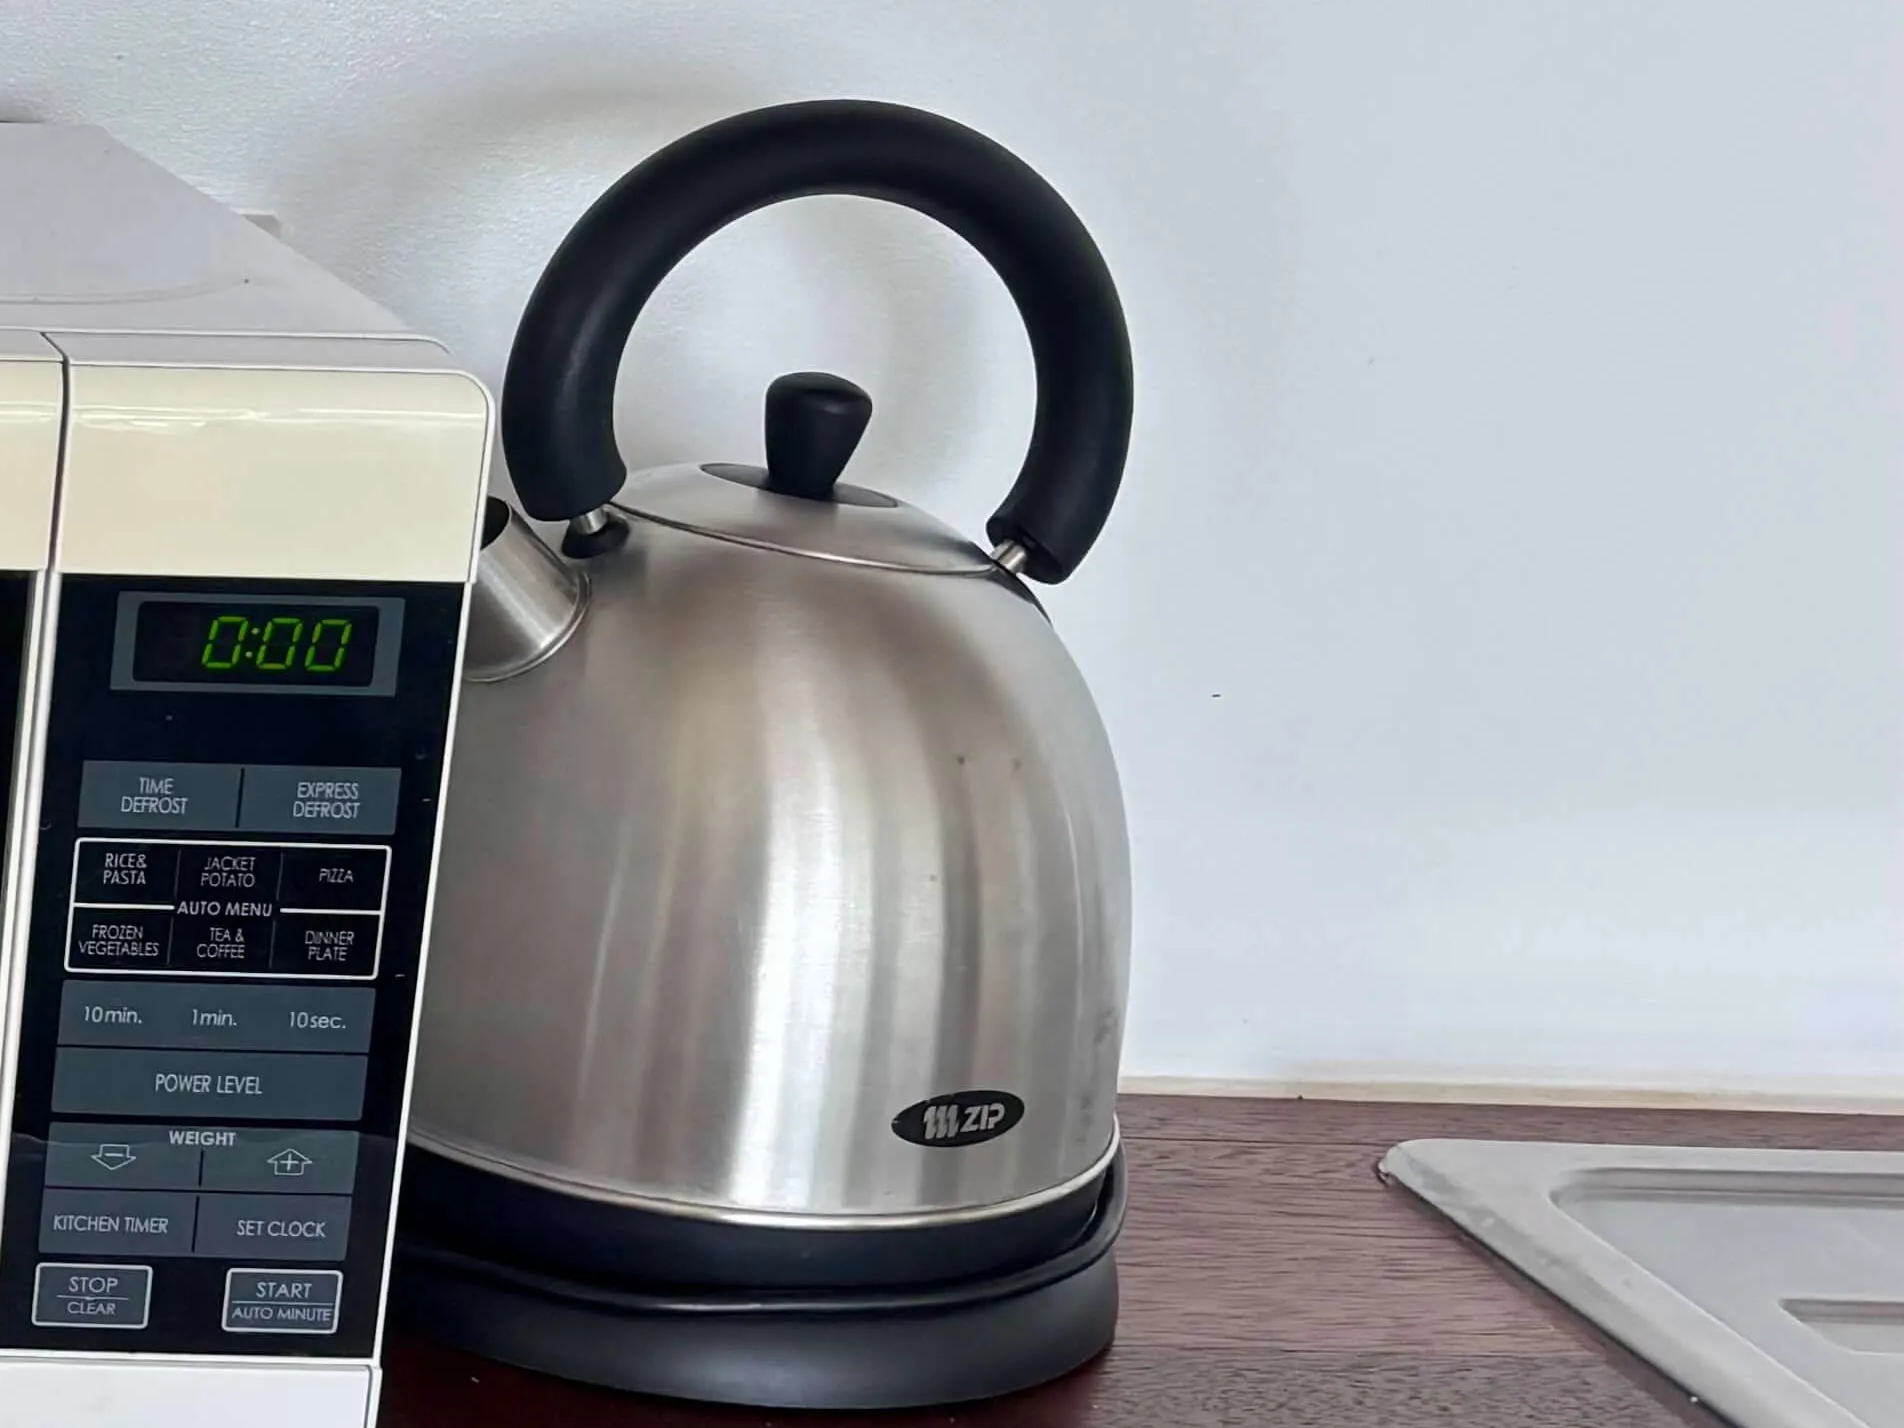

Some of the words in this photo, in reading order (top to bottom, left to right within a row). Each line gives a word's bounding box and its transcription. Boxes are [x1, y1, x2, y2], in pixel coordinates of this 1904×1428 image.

[202, 615, 352, 671] 0:00
[138, 777, 175, 795] TIME
[297, 782, 359, 800] EXPRESS
[120, 796, 188, 814] DEFROST
[293, 801, 361, 819] DEFROST
[204, 856, 256, 871] JACKET
[103, 869, 147, 885] PASTA
[200, 872, 255, 888] POTATO
[318, 868, 354, 883] PIZZA
[177, 901, 220, 917] AUTO
[225, 902, 273, 917] MENU
[92, 925, 143, 940] FROZEN
[209, 927, 232, 943] TEA
[234, 928, 245, 943] &
[305, 930, 355, 945] DINNER
[78, 941, 159, 957] VEGETABLES
[196, 943, 245, 959] COFFEE
[307, 946, 348, 962] PLATE
[155, 1074, 210, 1093] POWER
[216, 1076, 263, 1095] LEVEL
[960, 1102, 1005, 1133] ZIP
[168, 1130, 237, 1146] WEIGHT
[53, 1215, 121, 1233] KITCHEN
[125, 1216, 169, 1234] TIMER
[236, 1219, 263, 1237] SET
[268, 1219, 326, 1238] CLOCK
[68, 1276, 118, 1294] STOP
[256, 1282, 313, 1300] START
[66, 1300, 116, 1316] CLEAR
[232, 1306, 273, 1321] AUTO
[276, 1307, 332, 1323] MINUTE
